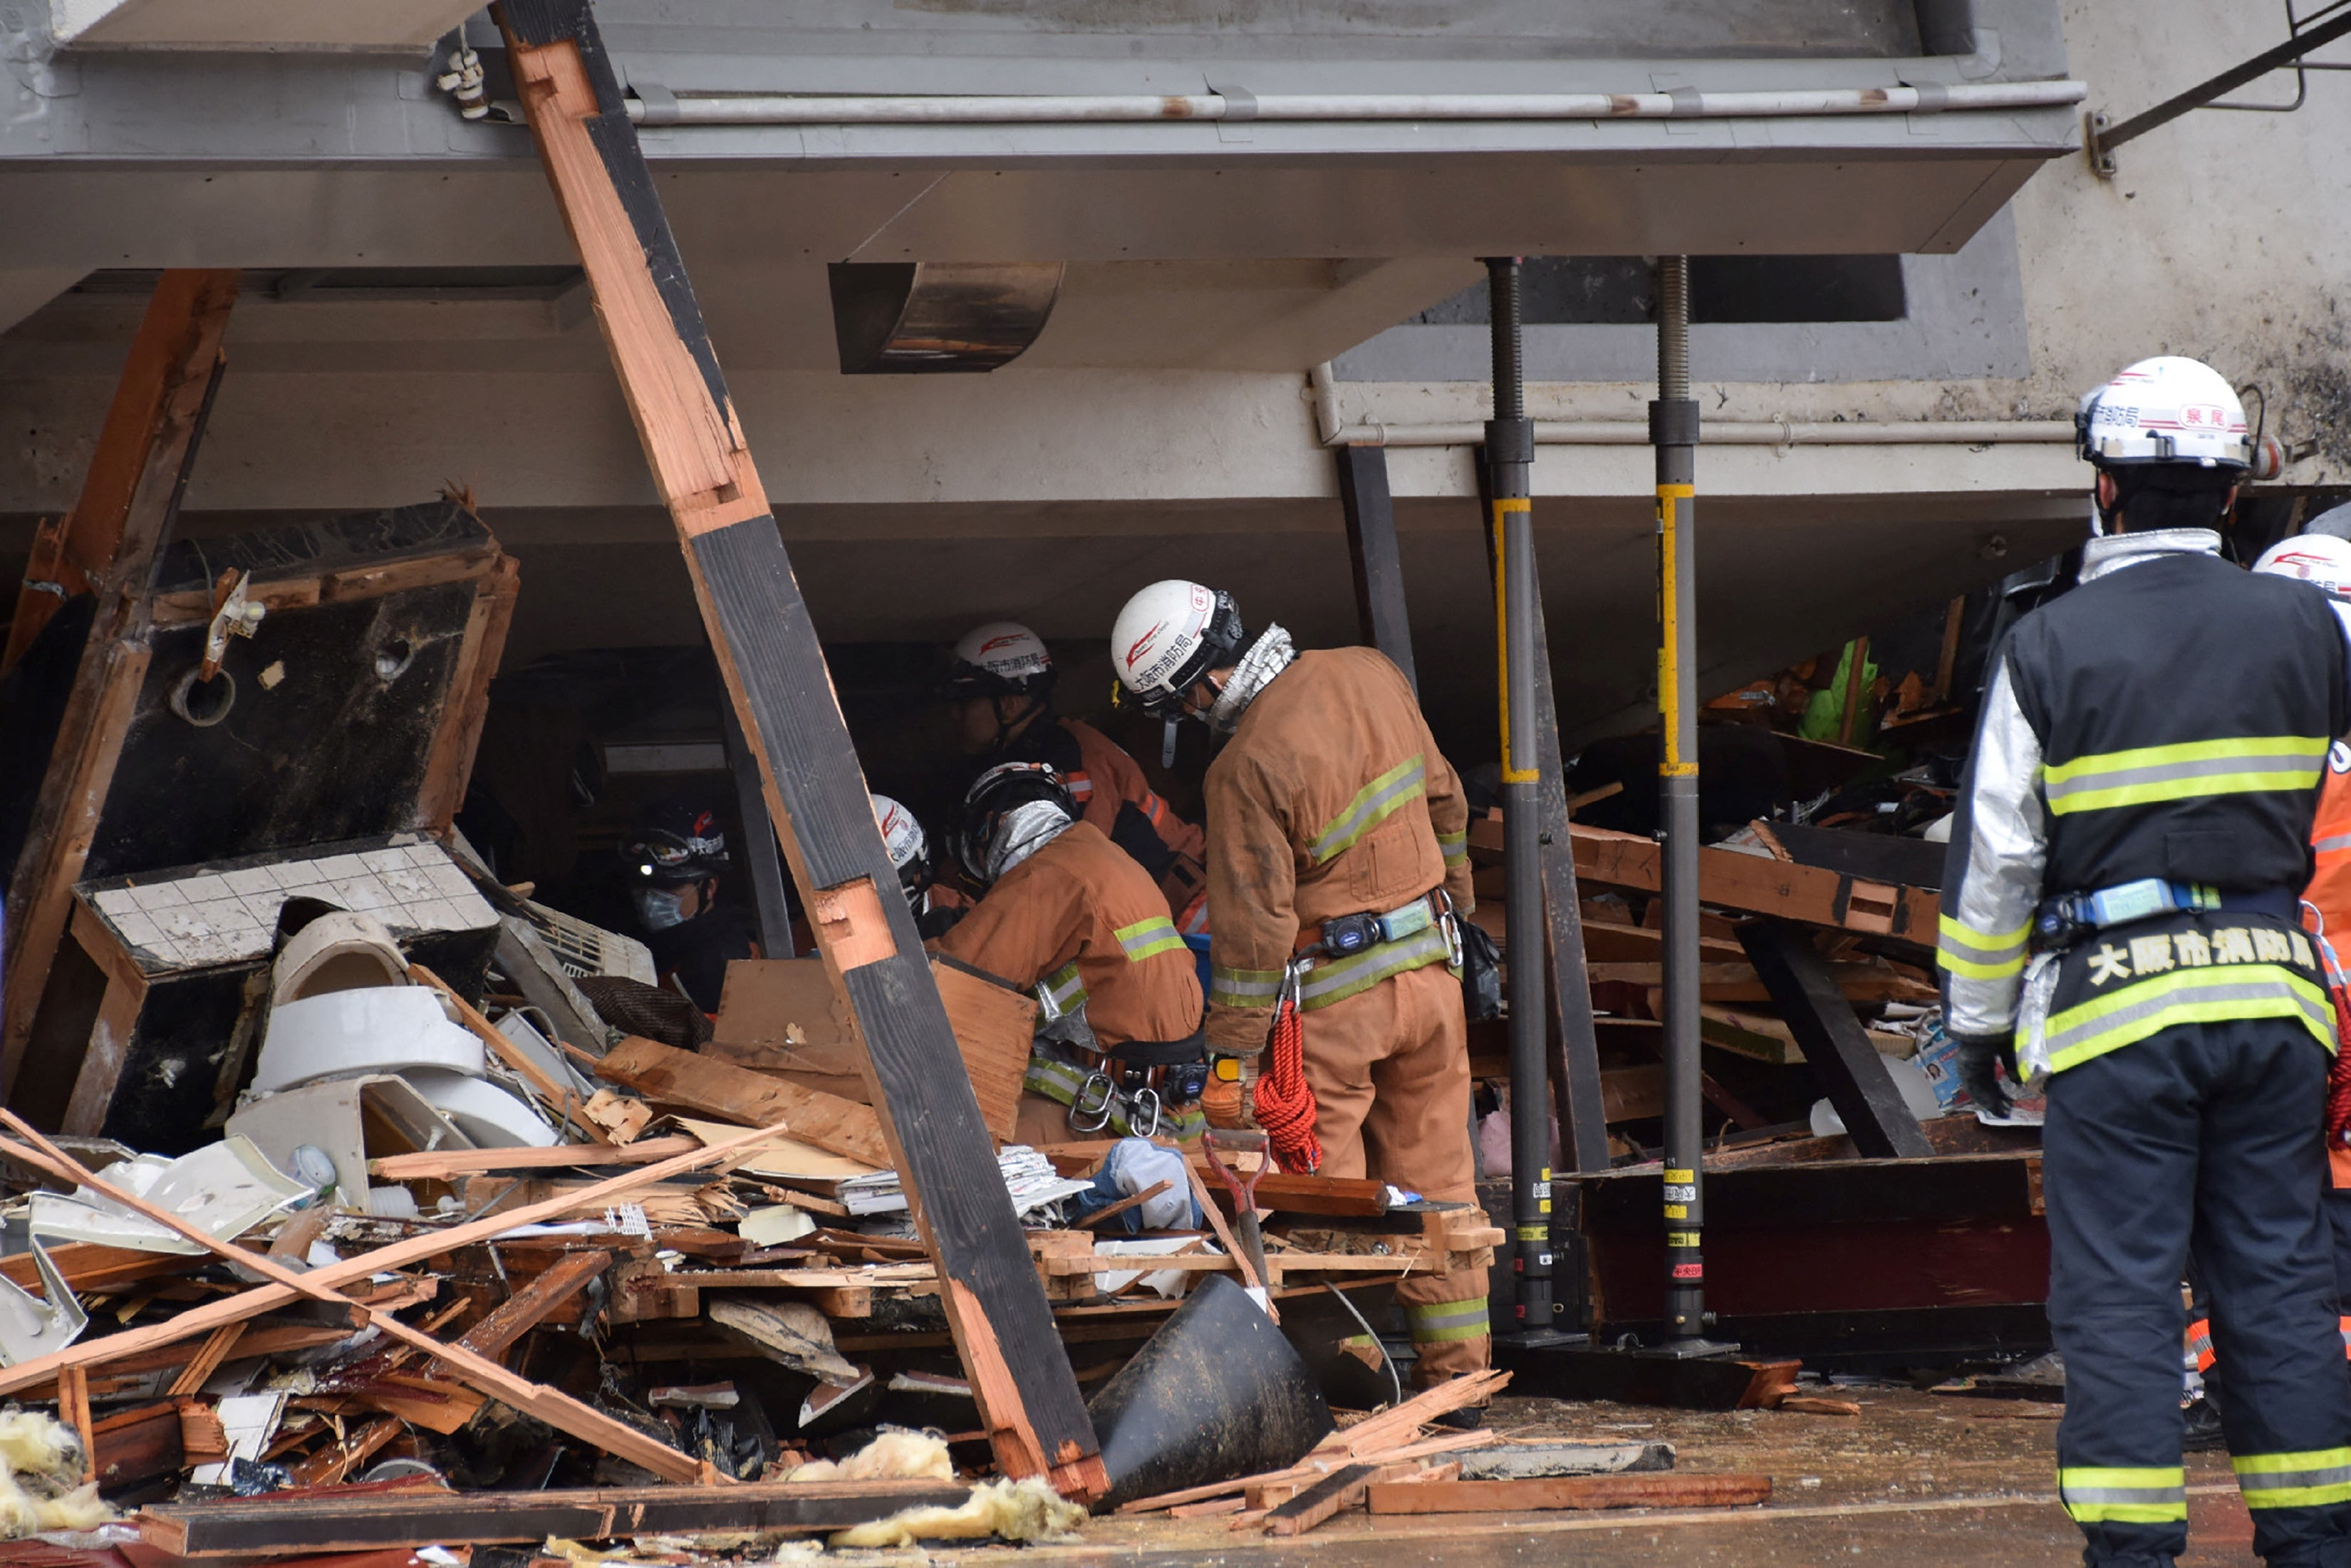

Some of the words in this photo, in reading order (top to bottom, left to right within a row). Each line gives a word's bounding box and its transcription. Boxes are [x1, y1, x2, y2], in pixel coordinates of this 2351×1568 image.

[1135, 634, 1193, 690] 大阪市消防局
[2087, 926, 2316, 986] 大阪市消防局
